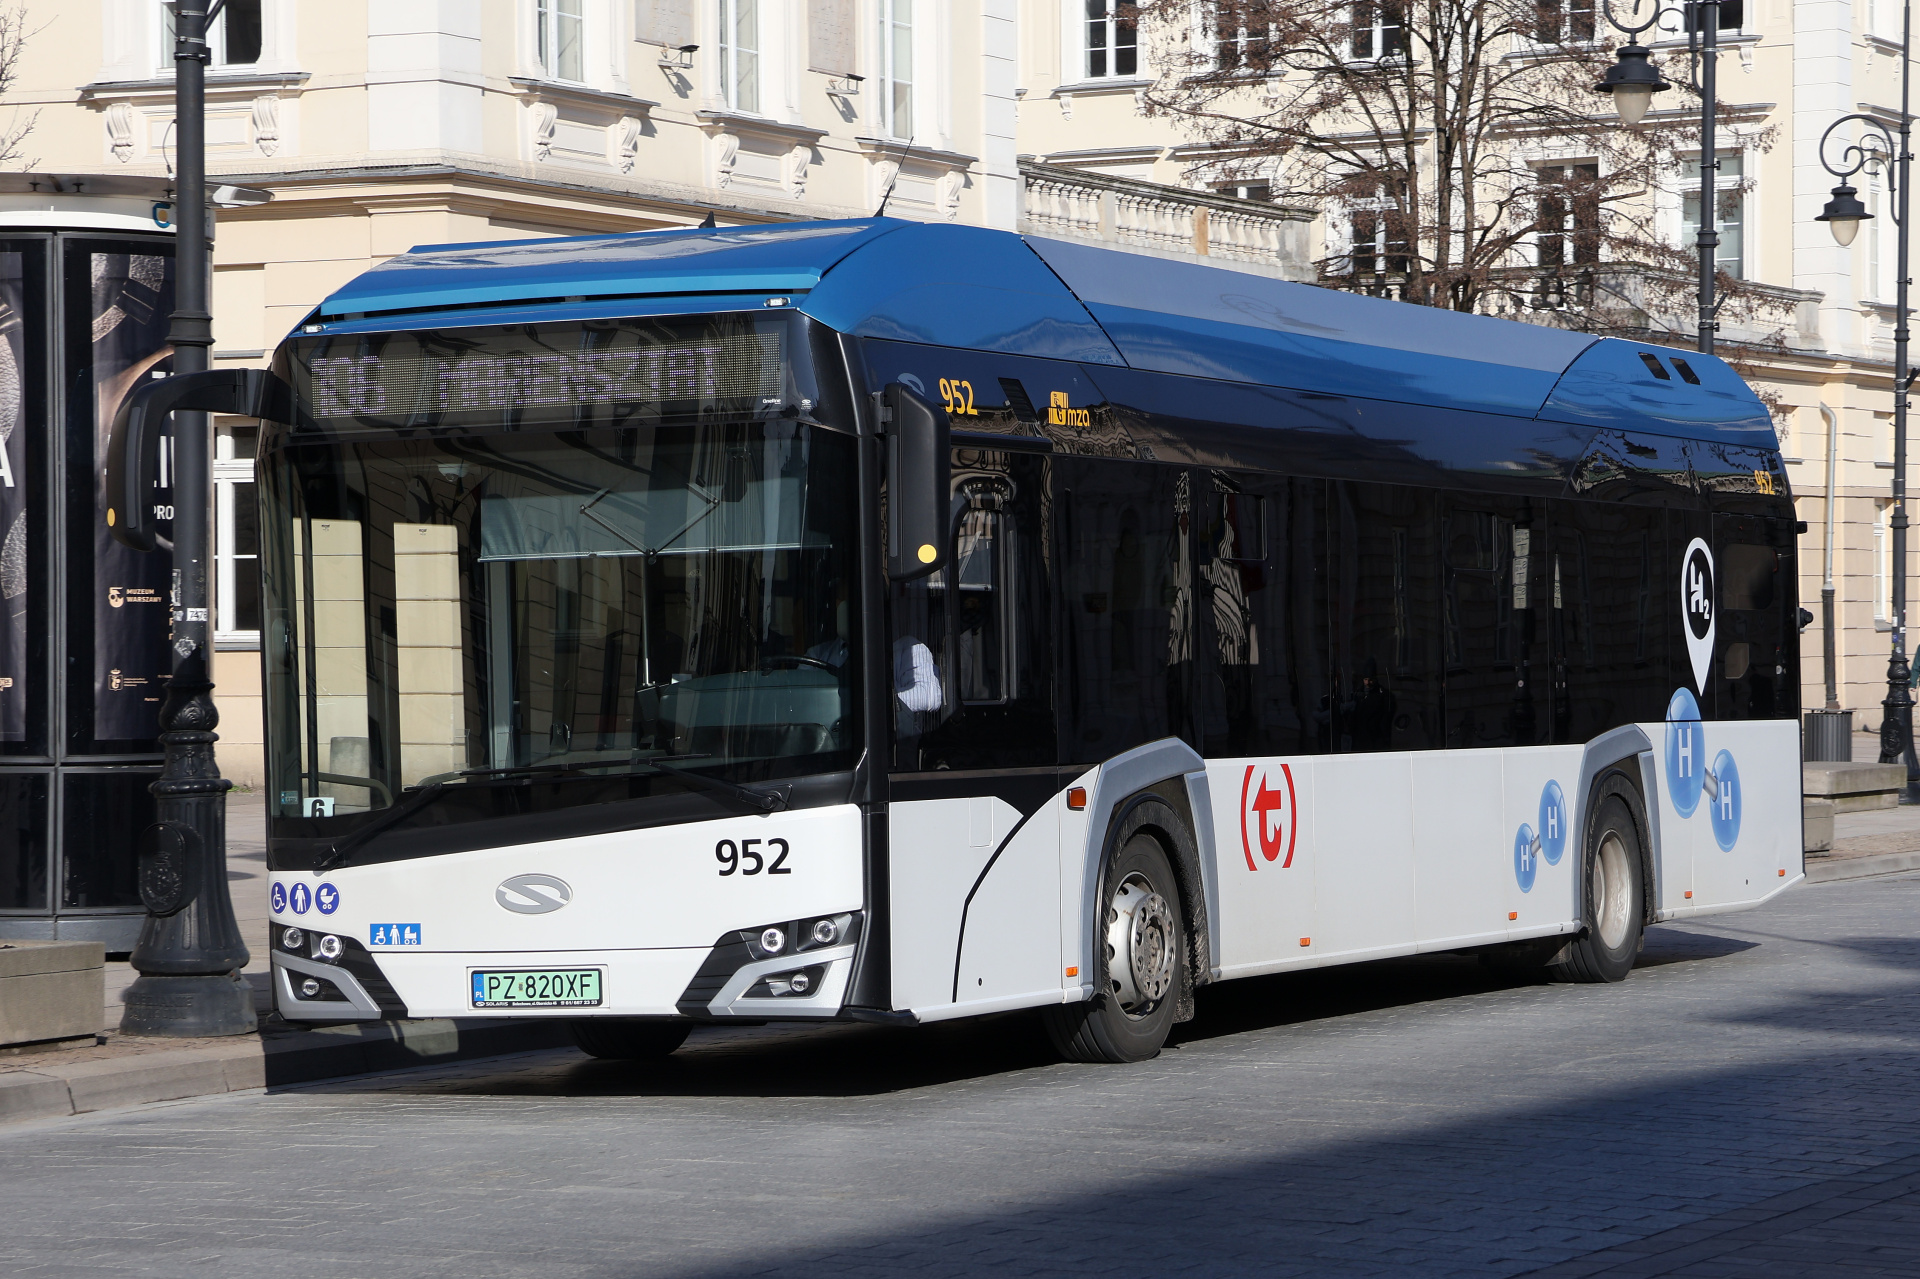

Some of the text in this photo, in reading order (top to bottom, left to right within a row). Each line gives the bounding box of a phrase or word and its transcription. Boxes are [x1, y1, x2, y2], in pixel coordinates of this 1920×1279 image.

[938, 377, 978, 416] 952
[1067, 408, 1090, 427] mza
[1754, 469, 1775, 495] 952
[1678, 727, 1692, 778] H
[1720, 780, 1733, 821] H
[1547, 805, 1558, 839] H
[714, 837, 792, 877] 952
[1520, 844, 1530, 872] H
[488, 973, 593, 1000] PZ 820XF
